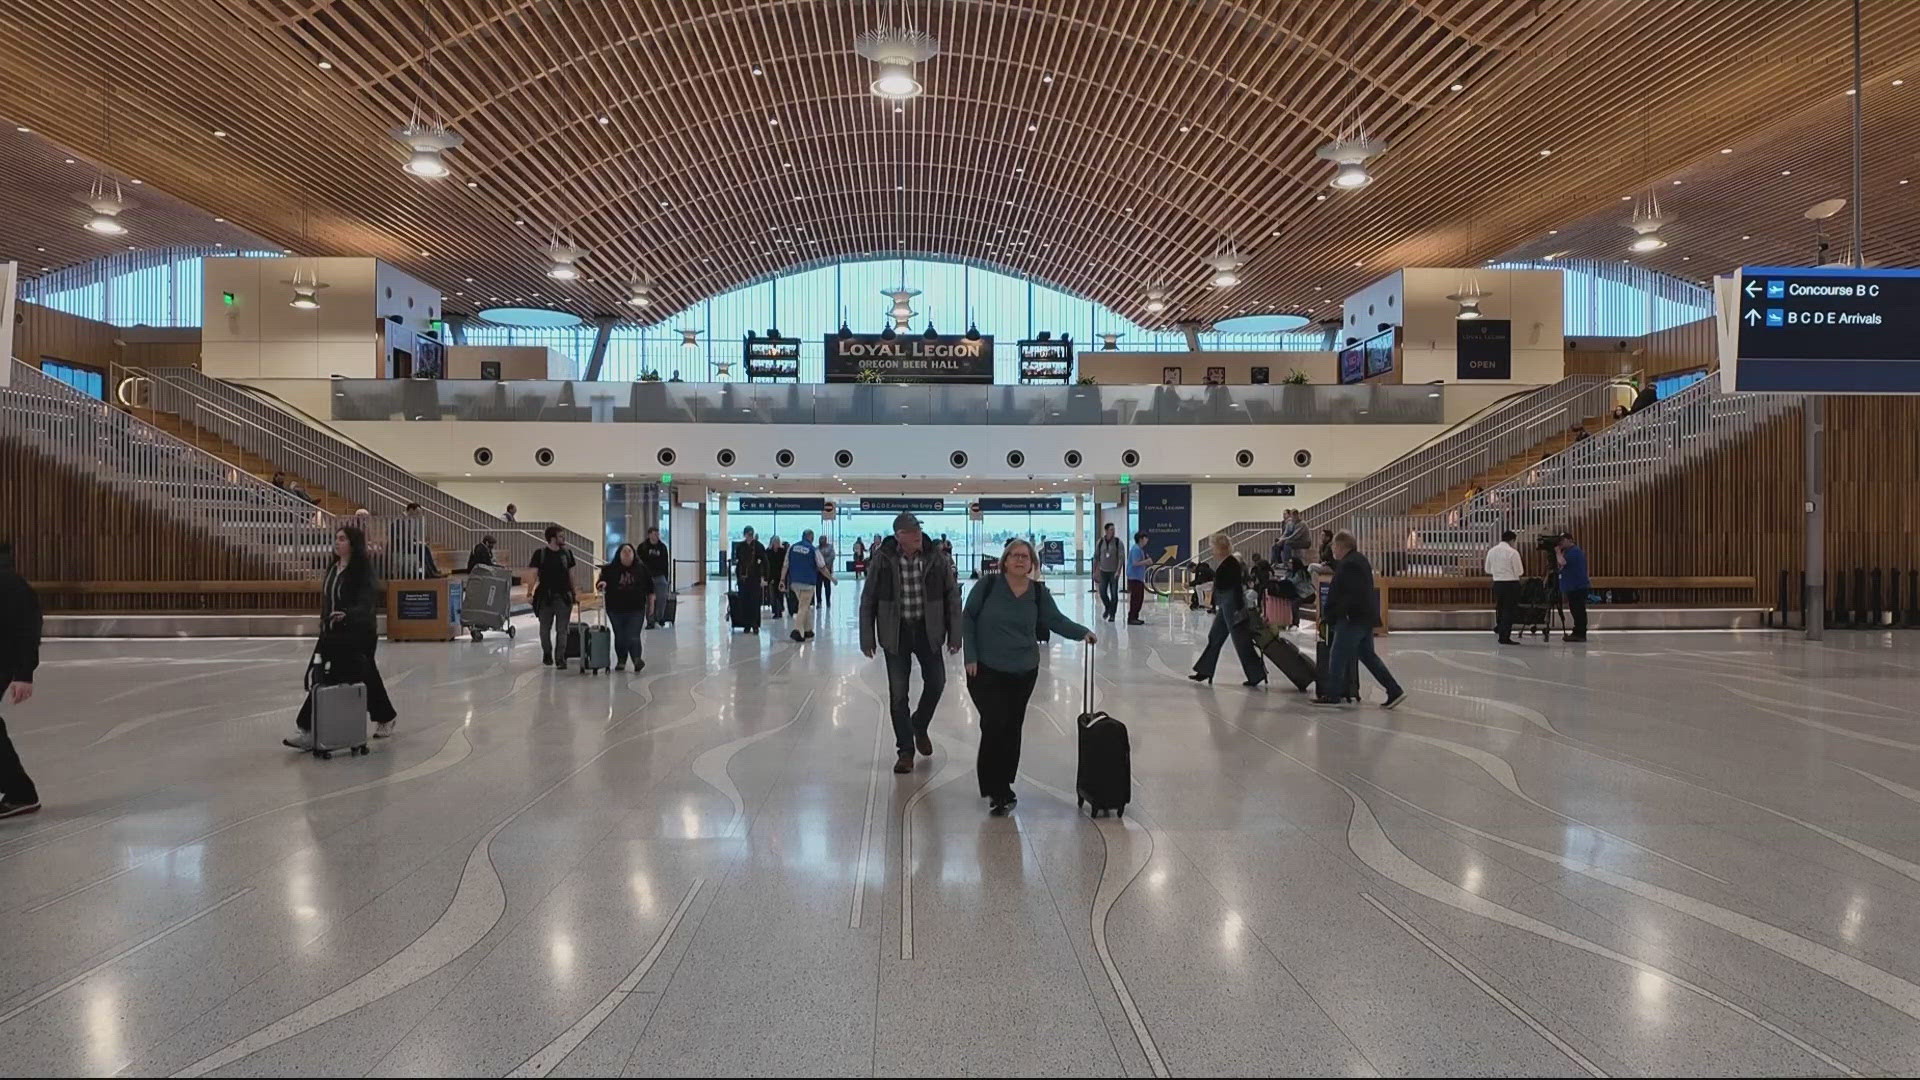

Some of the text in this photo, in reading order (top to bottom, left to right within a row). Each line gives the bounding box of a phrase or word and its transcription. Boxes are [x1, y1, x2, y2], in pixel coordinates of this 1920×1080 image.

[1789, 283, 1880, 297] Concourse B C
[1787, 311, 1882, 325] B C D E Arrivals
[838, 341, 980, 357] LOYAL LEGION
[858, 359, 959, 369] OREGON BEER HALL
[1469, 360, 1496, 369] OPEN
